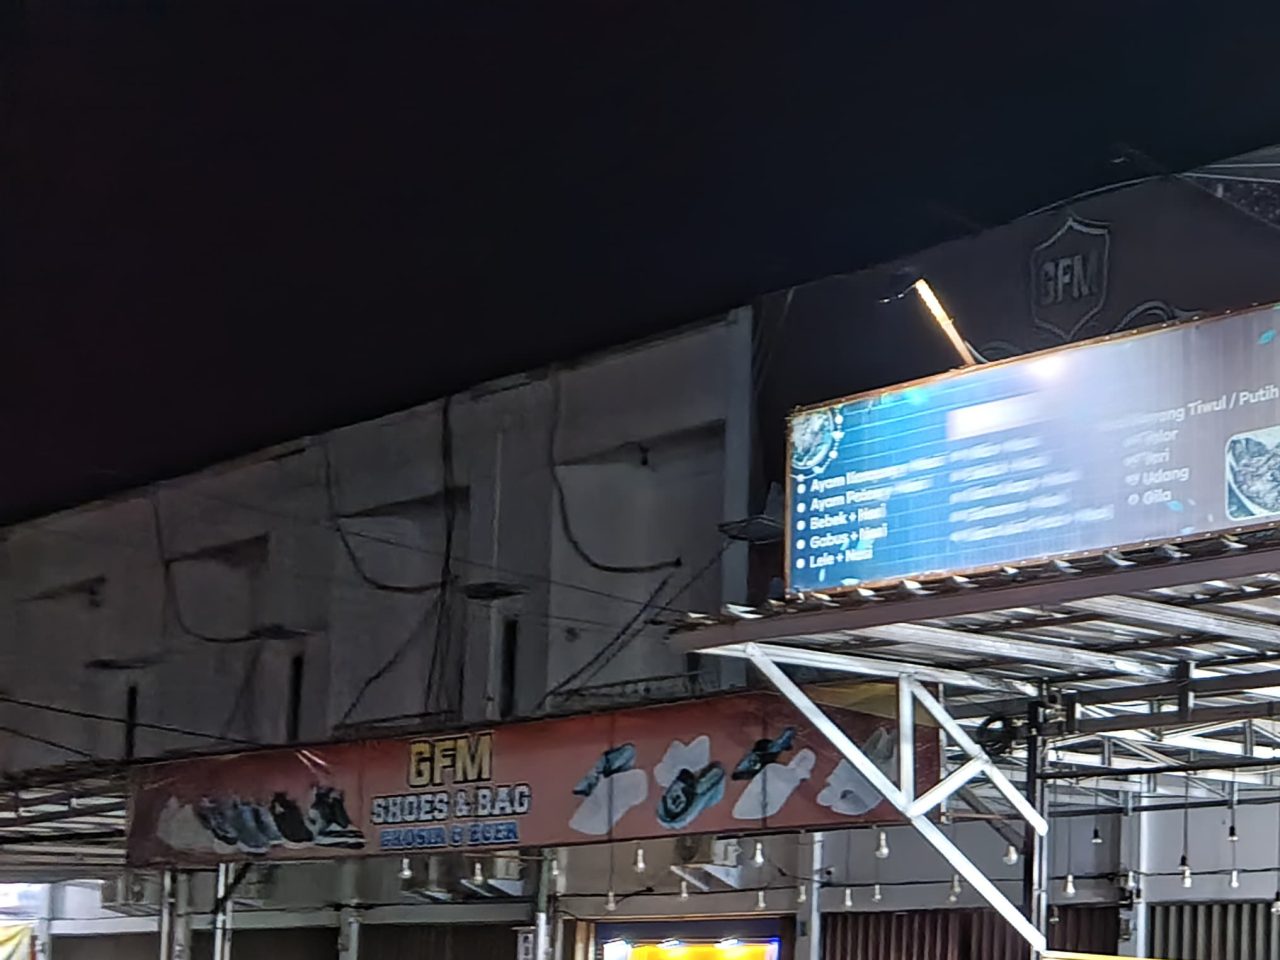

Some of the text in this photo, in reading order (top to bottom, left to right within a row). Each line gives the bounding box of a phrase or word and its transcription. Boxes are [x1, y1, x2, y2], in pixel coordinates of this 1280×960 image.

[1239, 385, 1280, 406] Putih
[1142, 467, 1190, 485] Udang
[408, 732, 493, 788] GFM
[371, 784, 532, 824] SHOES & BAG
